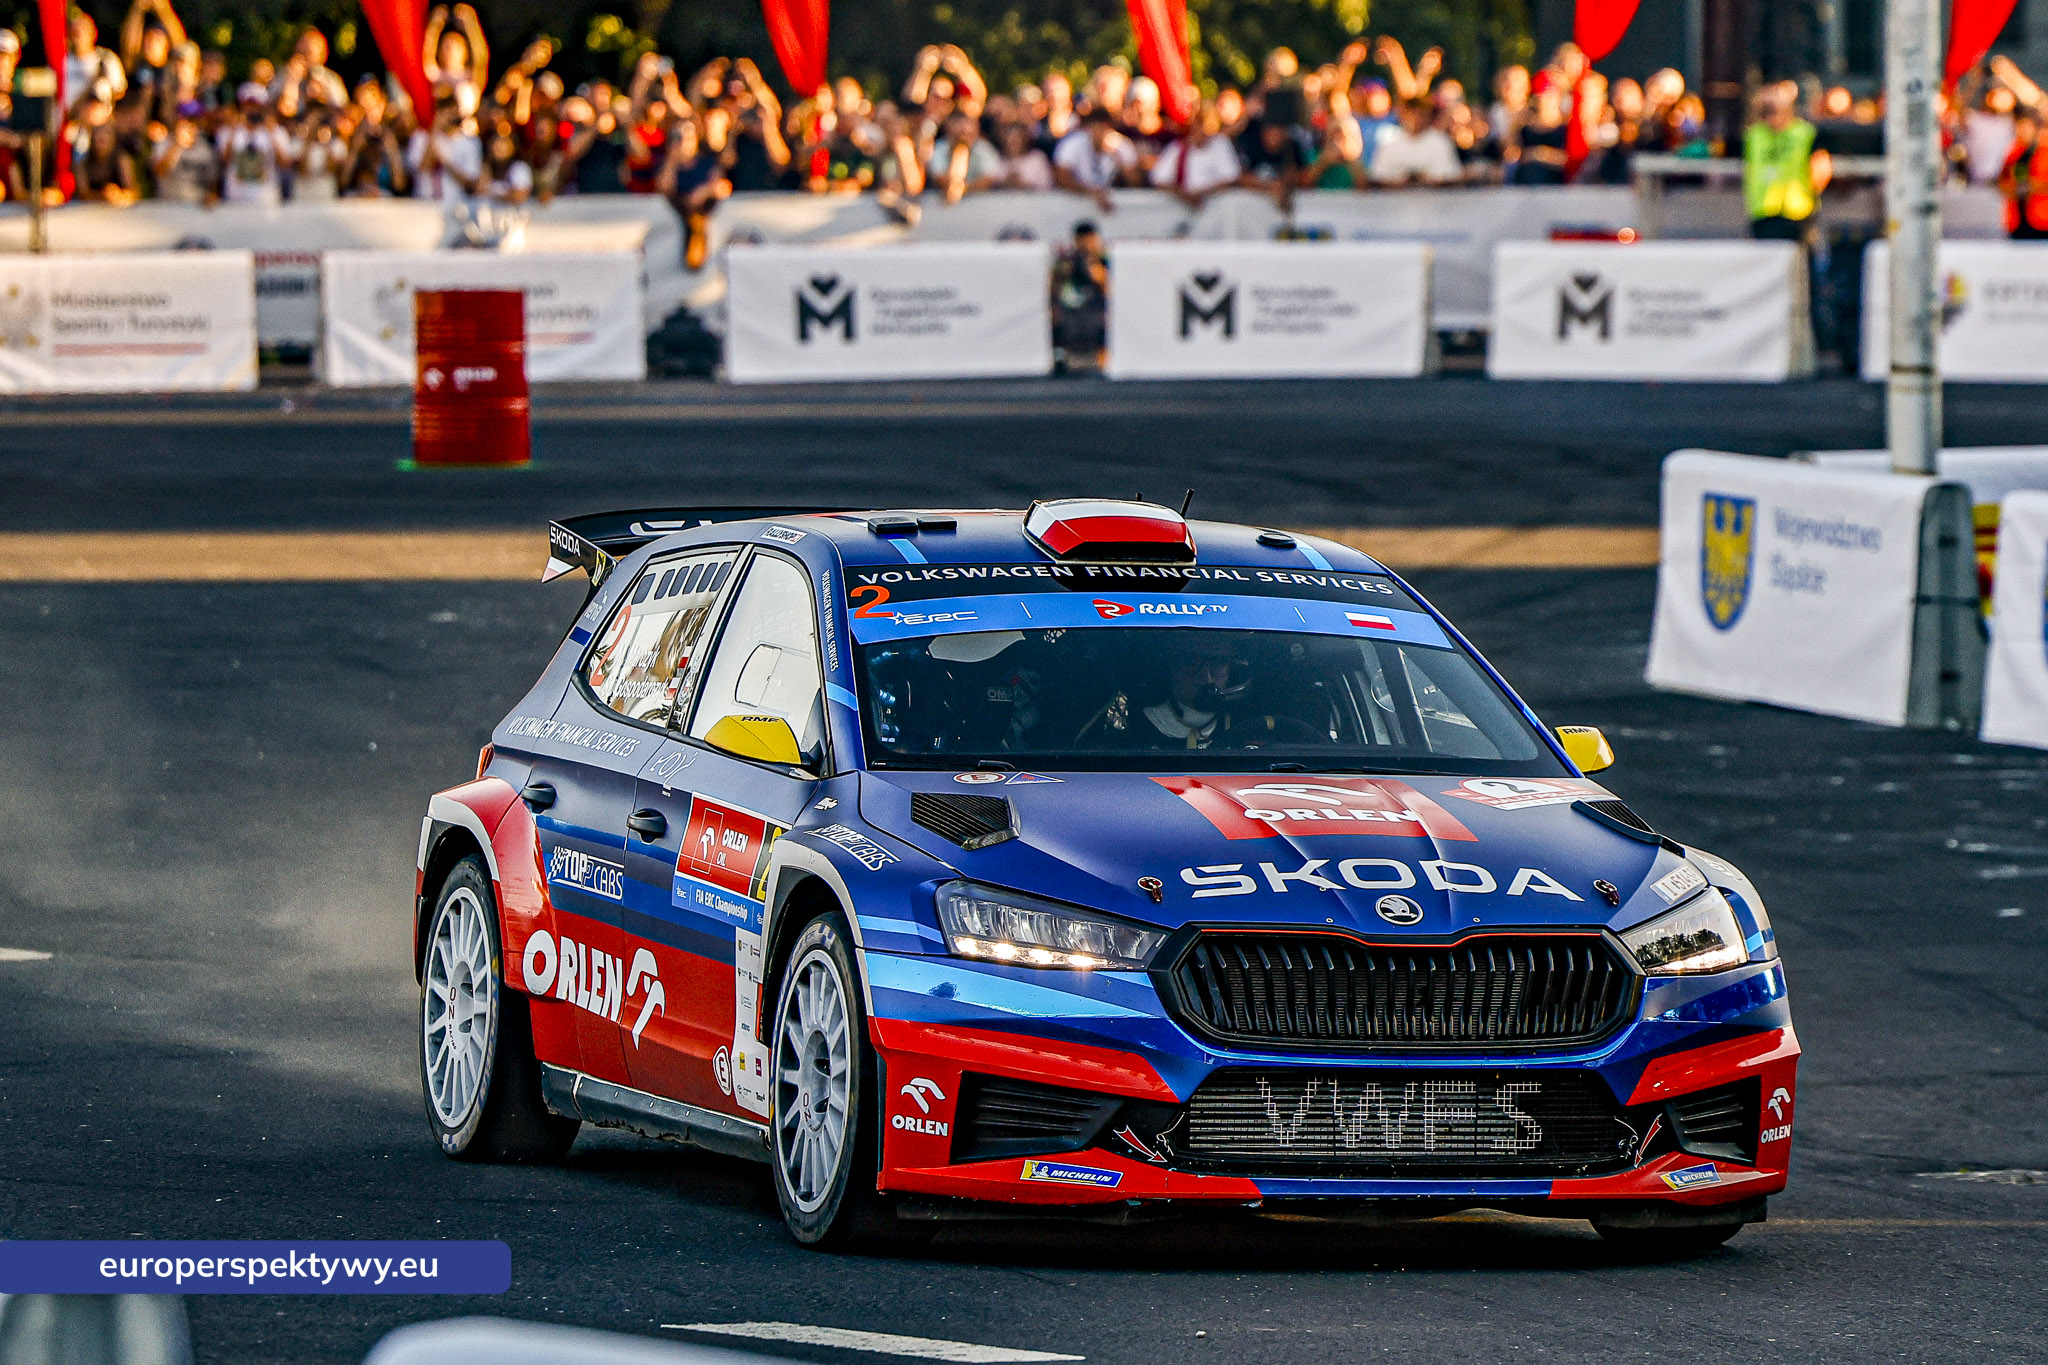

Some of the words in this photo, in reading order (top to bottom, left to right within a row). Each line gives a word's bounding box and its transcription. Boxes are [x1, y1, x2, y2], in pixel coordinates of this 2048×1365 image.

[858, 565, 1073, 584] VOLKSWAGEN
[1088, 565, 1250, 582] FINANCIAL
[1256, 571, 1394, 595] SERVICES
[850, 585, 894, 619] 2
[824, 607, 835, 643] FINANCIAL
[590, 605, 631, 686] 2
[827, 641, 839, 672] SERVICES
[505, 715, 558, 739] VOLKSWAGEN
[551, 722, 597, 749] FINANCIAL
[592, 731, 641, 757] SERVICES
[1482, 782, 1538, 794] 2
[1244, 808, 1424, 823] ORLEN
[721, 828, 749, 853] ORLEN
[716, 851, 726, 867] OIL
[594, 865, 624, 900] CARS
[696, 889, 704, 905] FIA
[705, 892, 715, 909] ERC
[715, 895, 748, 923] Championship
[523, 930, 623, 1023] ORLEN
[892, 1115, 948, 1136] ORLEN
[1256, 1077, 1542, 1150] VWFS
[1760, 1124, 1791, 1144] ORLEN
[1050, 1169, 1112, 1182] MICHELIN
[1682, 1170, 1714, 1183] MICHELIN
